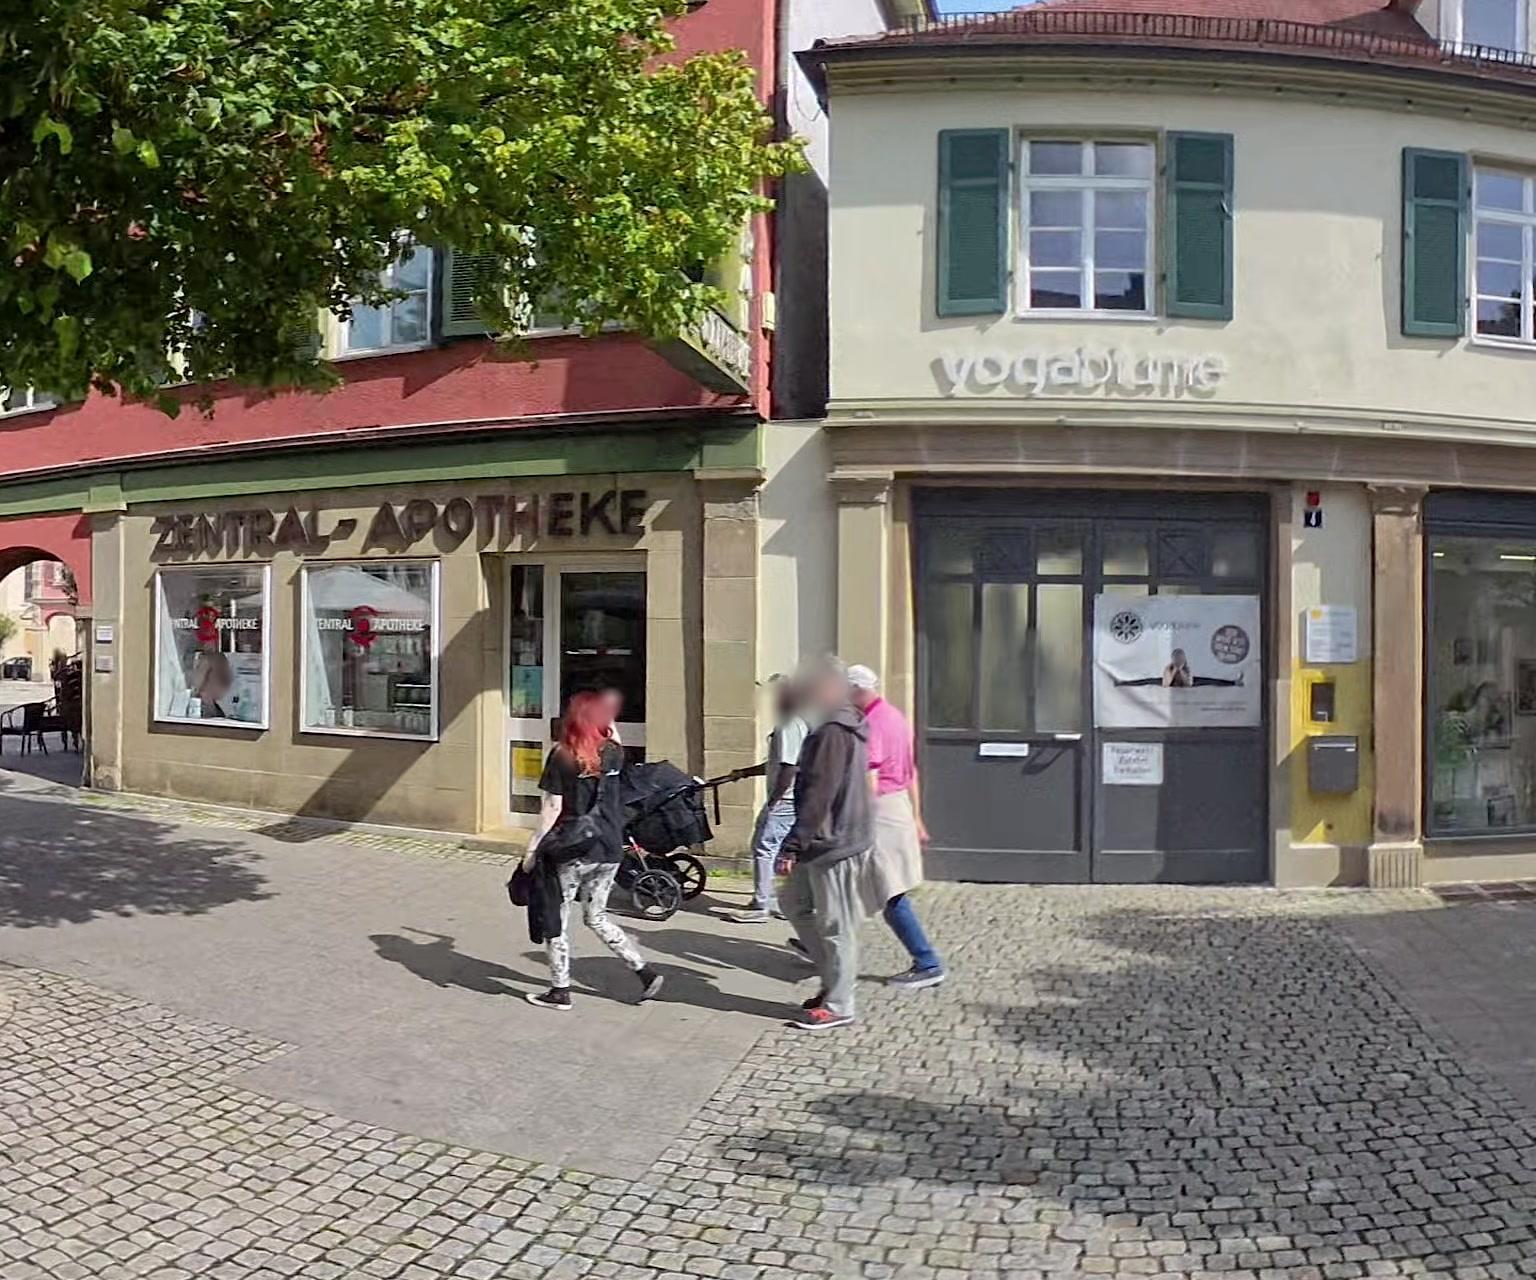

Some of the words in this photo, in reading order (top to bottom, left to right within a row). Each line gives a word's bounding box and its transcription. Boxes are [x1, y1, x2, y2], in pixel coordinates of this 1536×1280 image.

[940, 348, 1228, 395] yogablume
[364, 489, 648, 552] APOTHEKE
[214, 617, 260, 630] APOTHEKE
